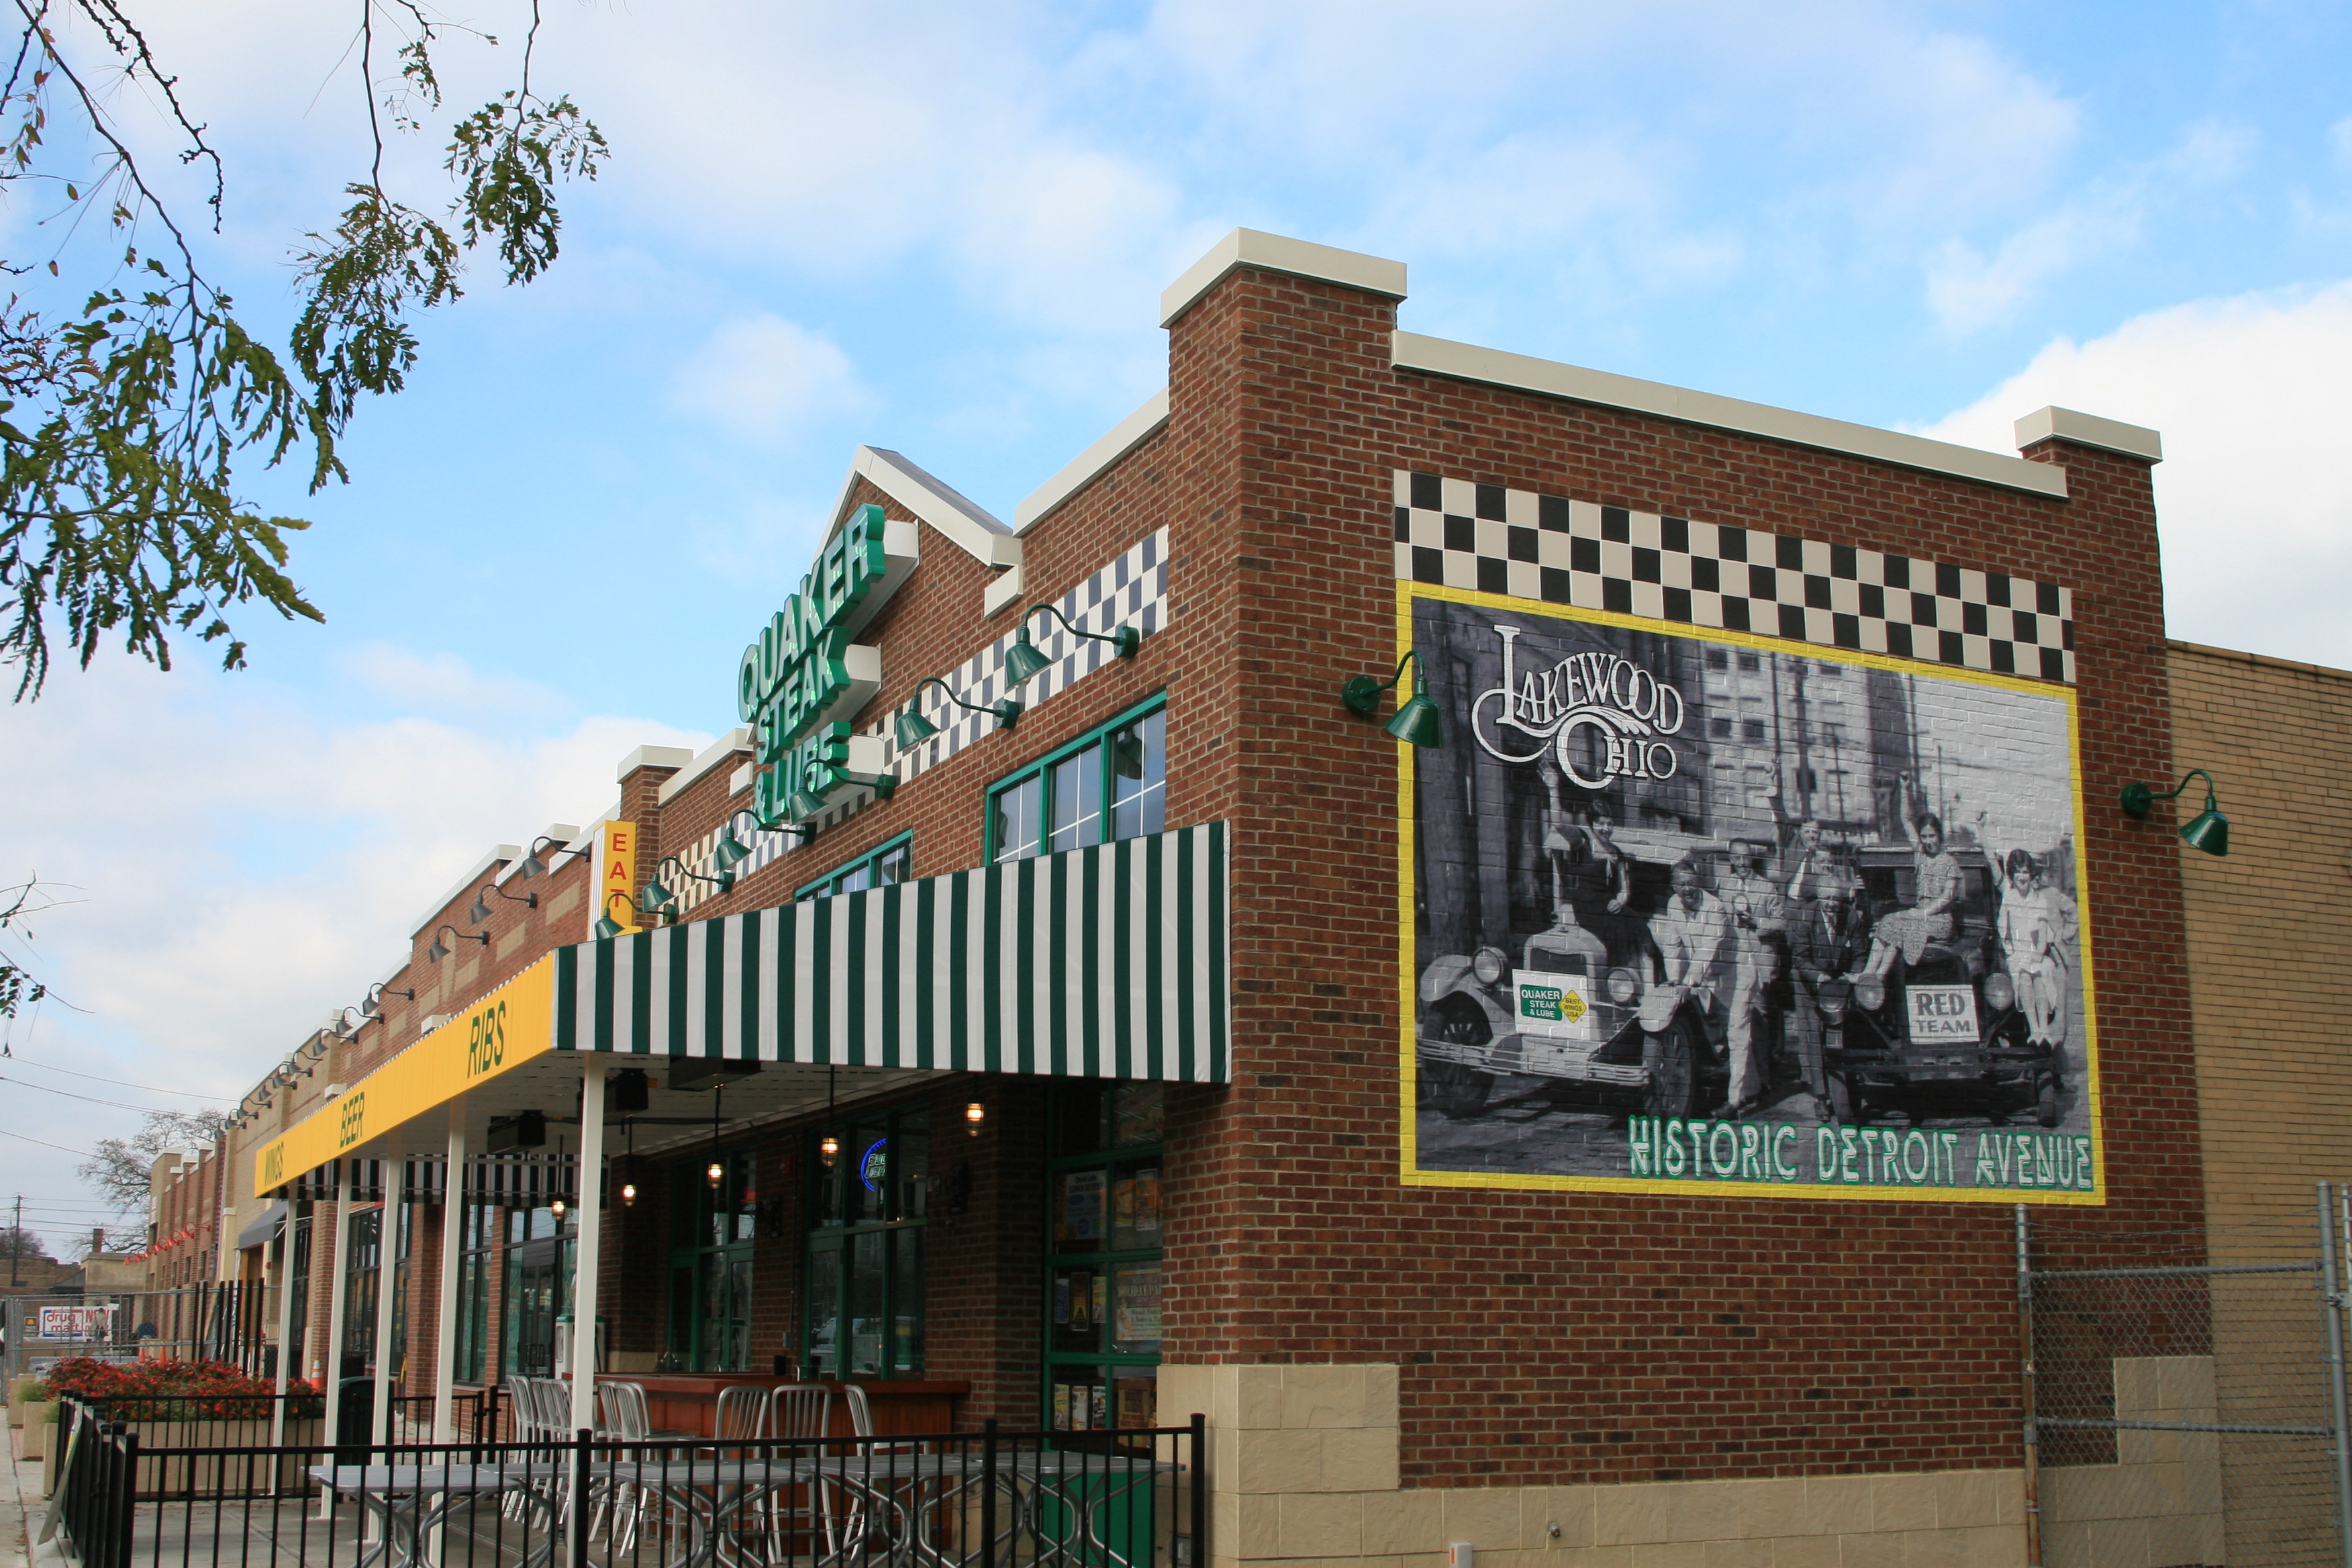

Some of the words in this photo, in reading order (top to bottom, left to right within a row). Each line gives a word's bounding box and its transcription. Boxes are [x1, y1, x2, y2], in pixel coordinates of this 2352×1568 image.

[738, 503, 885, 722] QUAKER
[756, 626, 851, 765] STEAK
[1471, 624, 1684, 763] LAKEWOOD
[752, 772, 781, 830] &
[772, 721, 851, 820] LUBE
[1556, 712, 1677, 790] OHIO
[609, 833, 627, 908] EAT
[1521, 989, 1561, 1000] QUAKER
[1530, 1000, 1557, 1009] STEAK
[1536, 1009, 1555, 1018] LUBE
[1916, 993, 1965, 1016] RED
[467, 1000, 506, 1079] RIBS
[1914, 1020, 1970, 1033] TEAM
[340, 1091, 364, 1148] BEER
[264, 1141, 284, 1187] WINGS
[1628, 1115, 1798, 1183] HISTORIC
[1817, 1124, 1959, 1187] DETROIT
[1975, 1130, 2094, 1191] AVENUE
[47, 1311, 76, 1325] drug
[51, 1322, 79, 1332] mart
